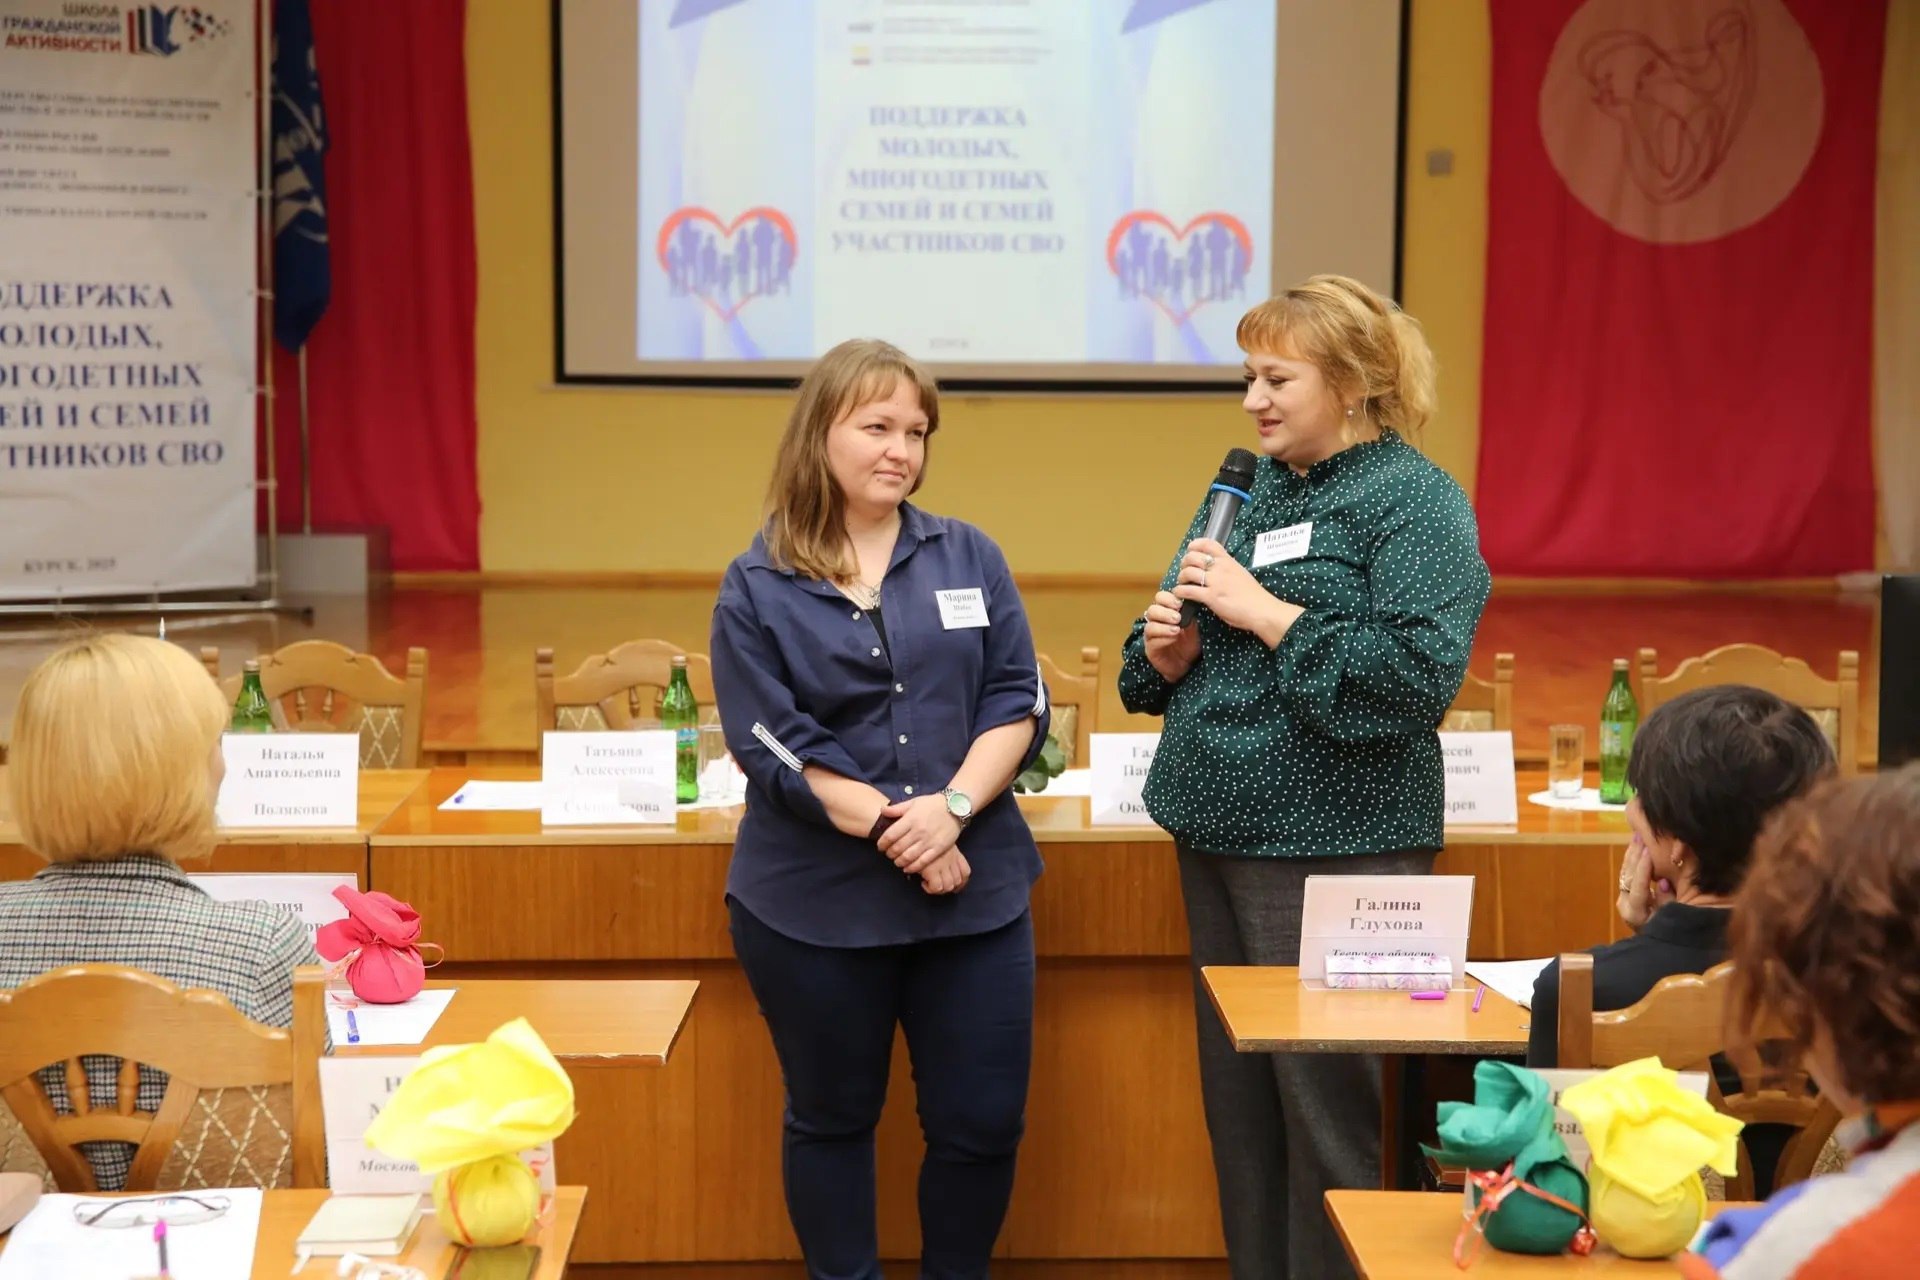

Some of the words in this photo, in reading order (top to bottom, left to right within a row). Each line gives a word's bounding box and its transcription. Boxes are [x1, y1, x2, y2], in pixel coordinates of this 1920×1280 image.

[5, 33, 121, 51] АКТИВНОСТИ
[868, 105, 1027, 128] ПОДДЕРЖКА
[879, 137, 1020, 159] МОЛОДЫХ,
[847, 169, 1049, 190] МНОГОДЕТНЫХ
[840, 197, 931, 220] СЕМЕЙ
[938, 201, 956, 220] И
[964, 197, 1054, 221] СЕМЕЙ
[832, 231, 1006, 252] УЧАСТНИКОВ
[1011, 233, 1065, 253] СВО
[58, 404, 78, 427] И
[91, 396, 211, 427] СЕМЕЙ
[157, 441, 224, 466] СВО
[943, 592, 977, 604] Марина
[261, 748, 325, 761] Наталья
[583, 745, 644, 758] Татьяна
[243, 767, 342, 780] Анатольевна
[571, 764, 655, 776] Алексеевна
[253, 803, 328, 817] Полякова
[1355, 898, 1421, 911] Галина
[1349, 917, 1424, 934] Глухова
